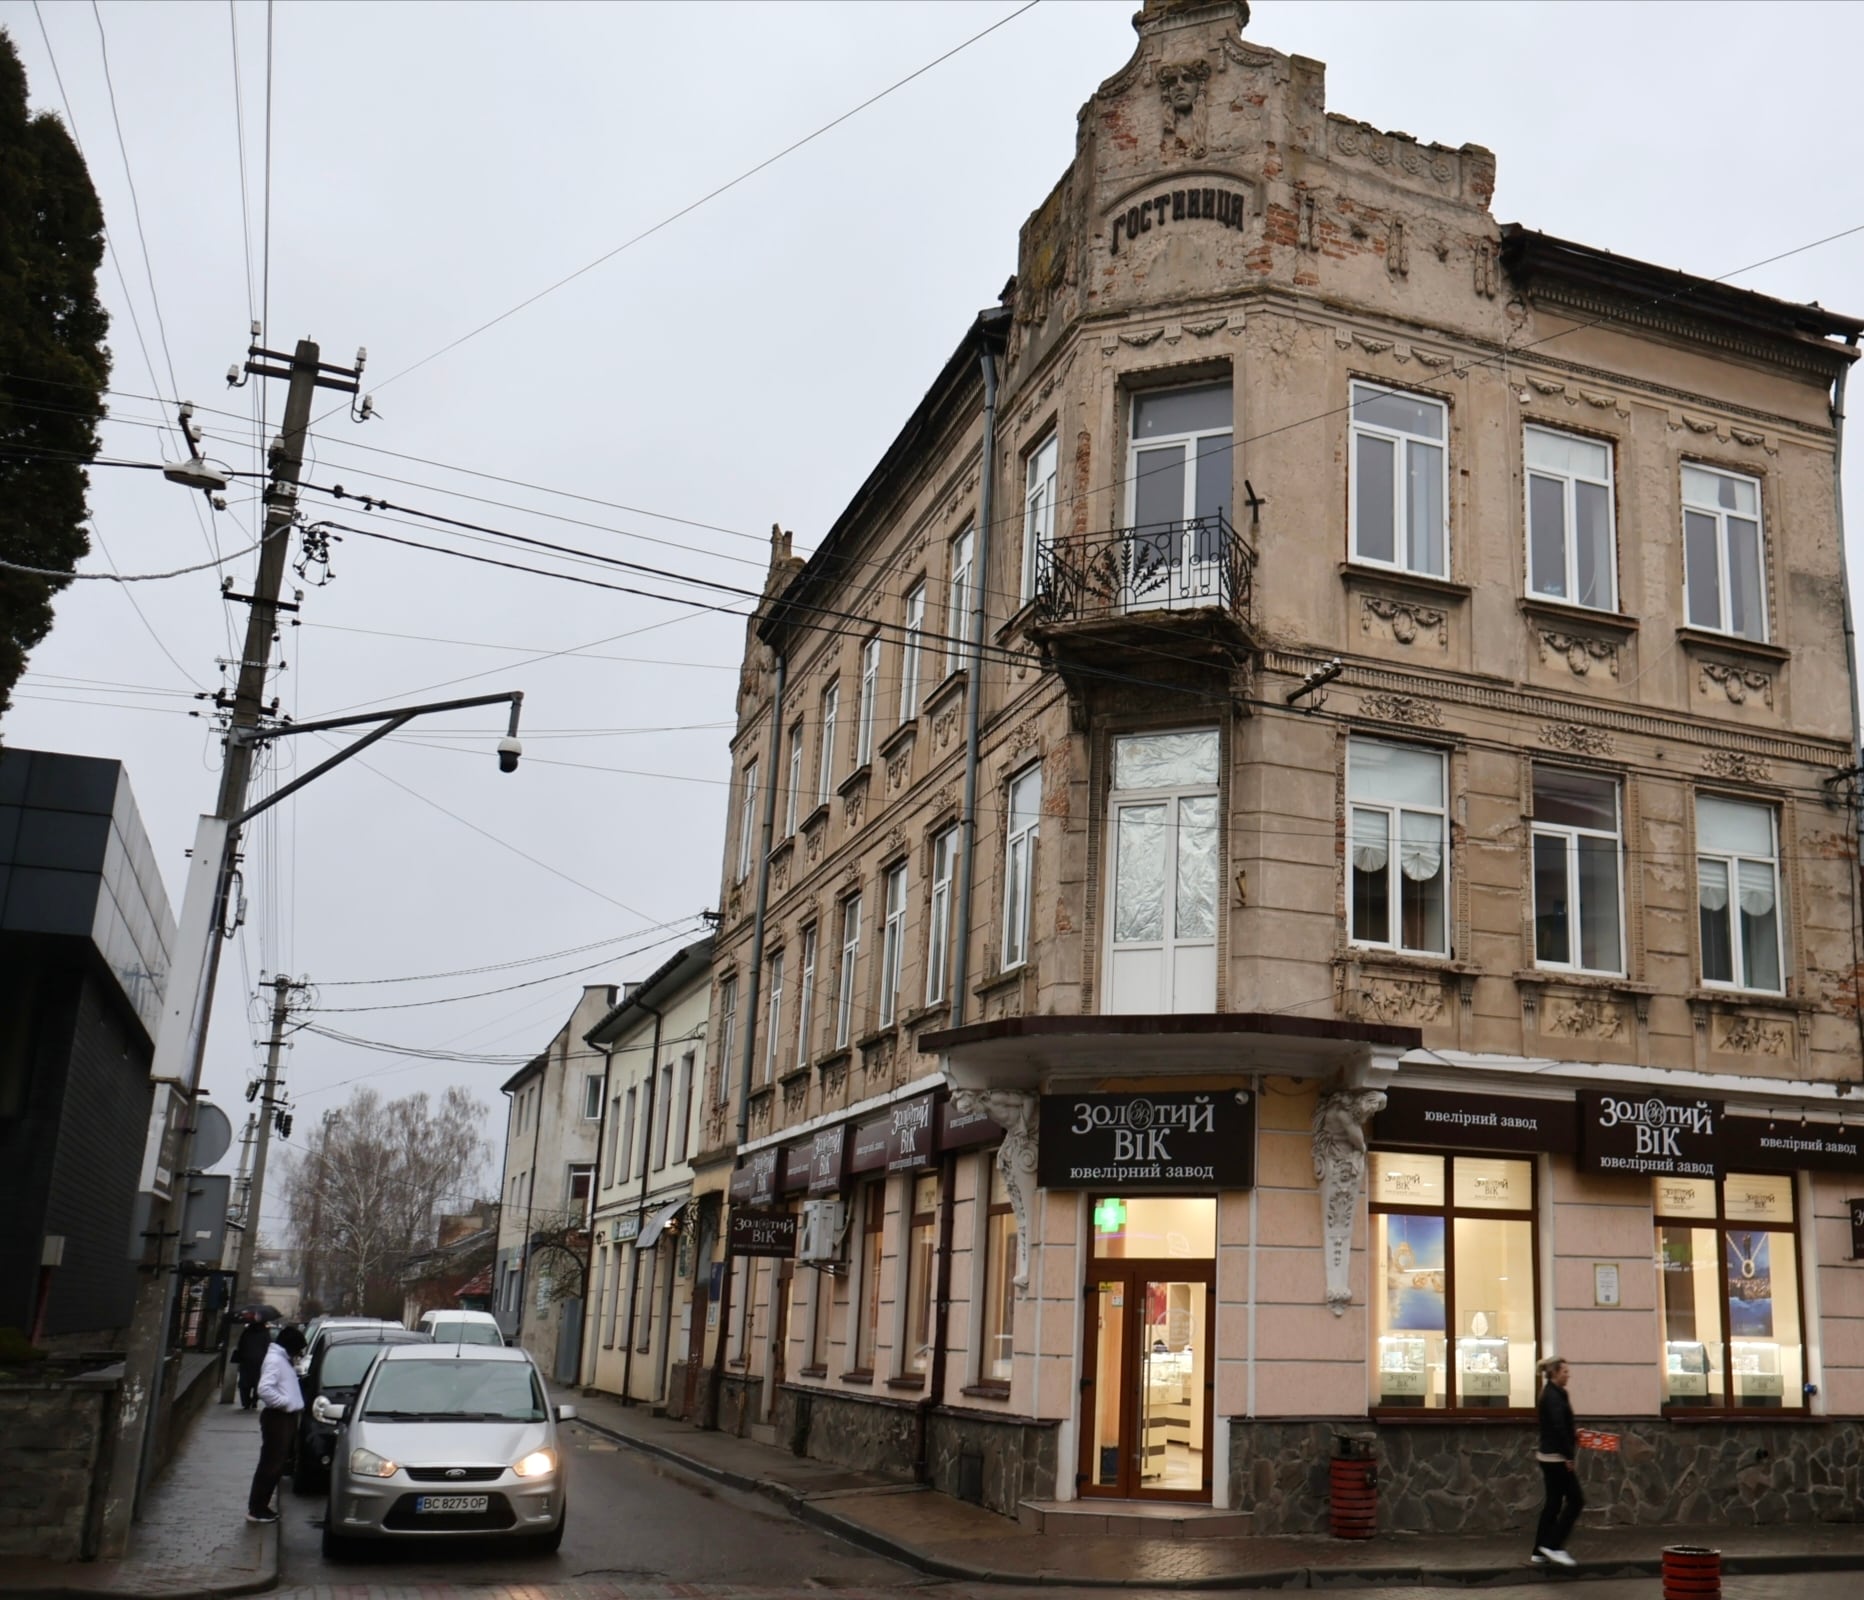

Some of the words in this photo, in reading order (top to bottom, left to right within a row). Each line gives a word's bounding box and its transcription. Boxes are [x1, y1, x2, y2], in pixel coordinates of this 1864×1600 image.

[1424, 1109, 1498, 1127] ювелірний
[1500, 1116, 1538, 1131] завод
[1760, 1135, 1823, 1152] ювелірний
[1825, 1142, 1857, 1156] завод
[1070, 1163, 1161, 1181] ювелірний
[1165, 1165, 1214, 1180] завод
[1600, 1155, 1674, 1173] ювелірний
[1676, 1161, 1715, 1176] завод
[424, 1497, 440, 1509] BC
[442, 1497, 469, 1509] 8275
